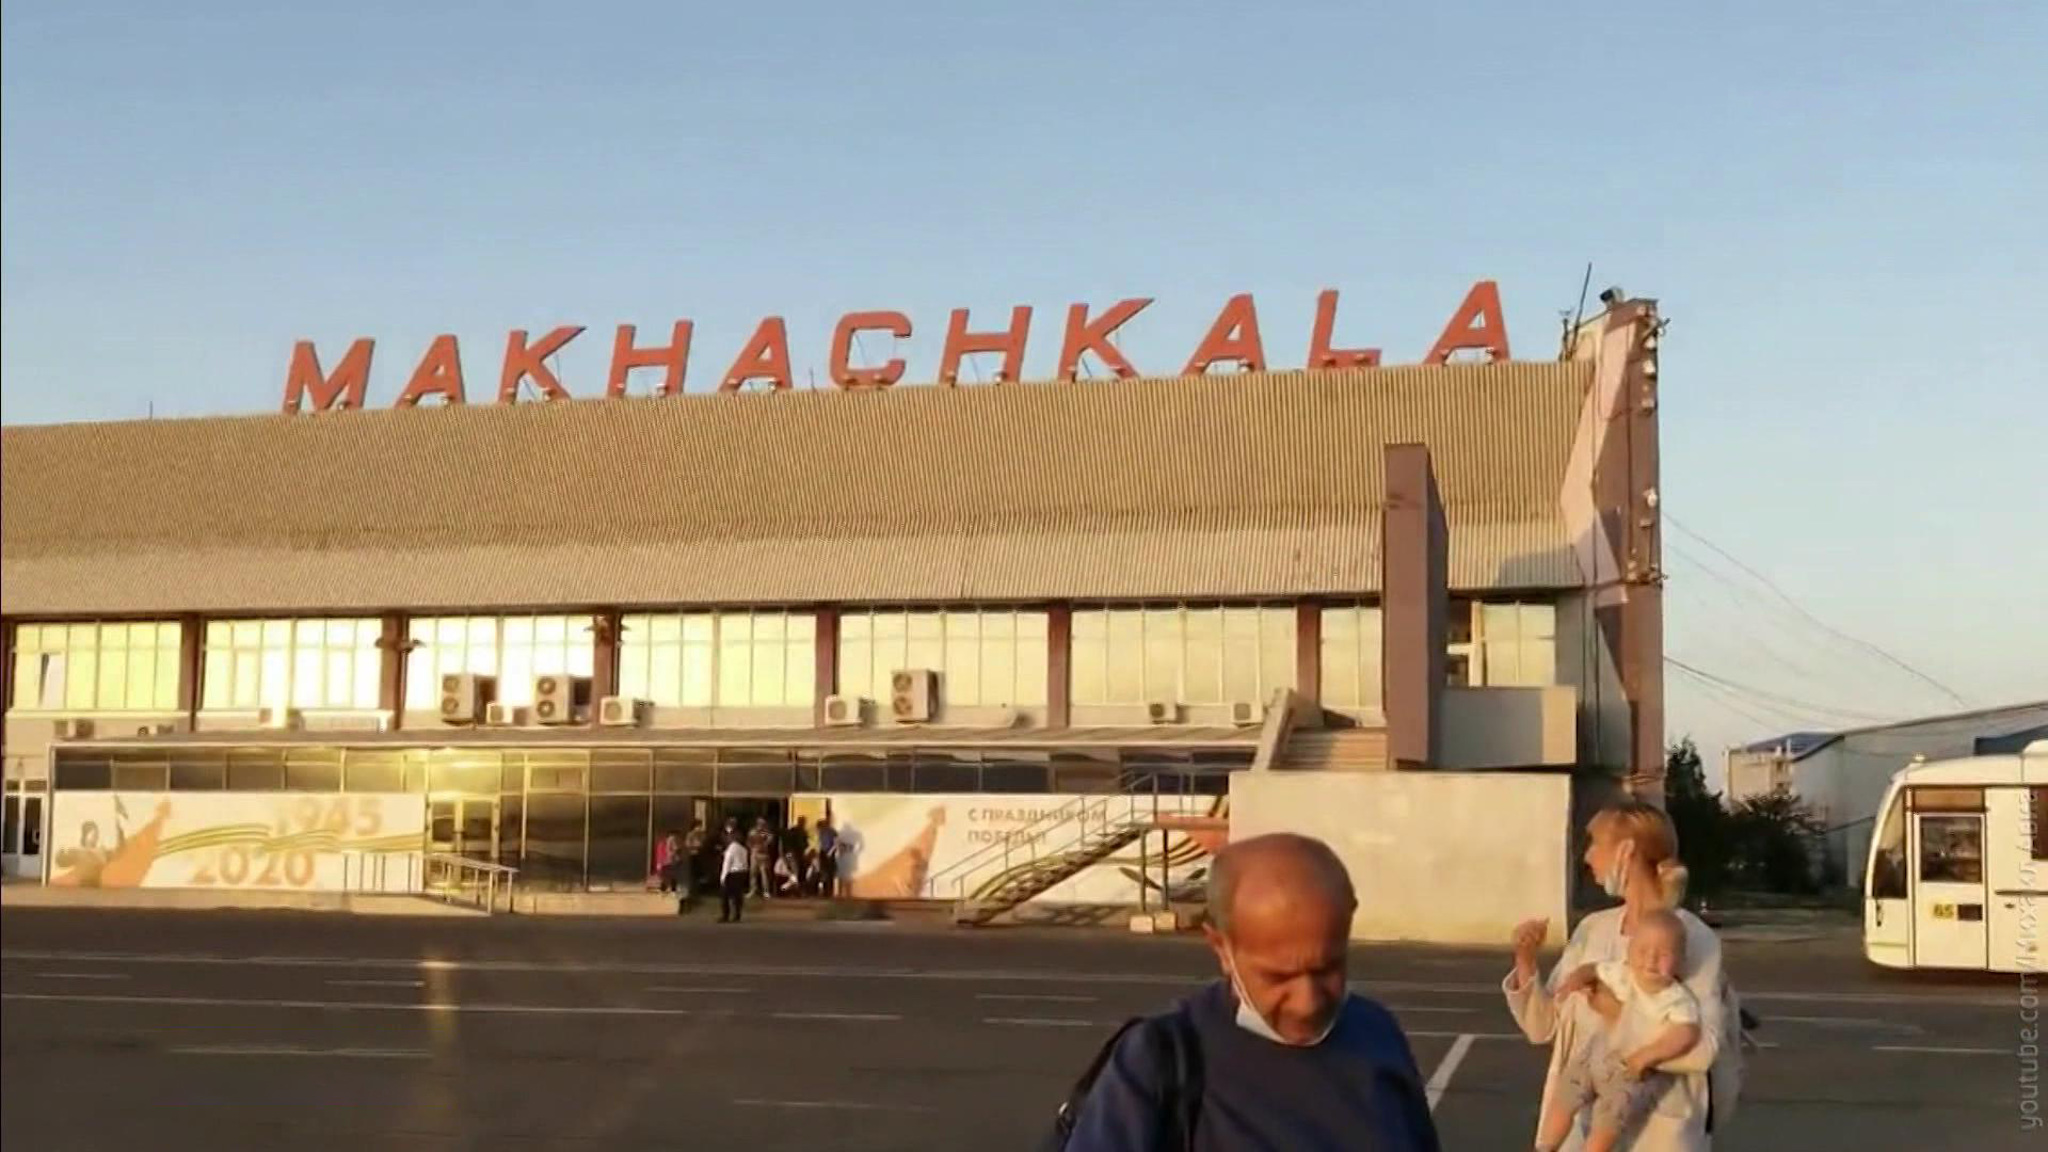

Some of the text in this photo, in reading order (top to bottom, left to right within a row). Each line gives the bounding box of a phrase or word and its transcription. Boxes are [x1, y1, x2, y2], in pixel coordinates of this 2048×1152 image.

[283, 280, 1511, 413] MAKHACHKALA
[275, 797, 383, 836] 1945
[190, 845, 315, 886] 2020
